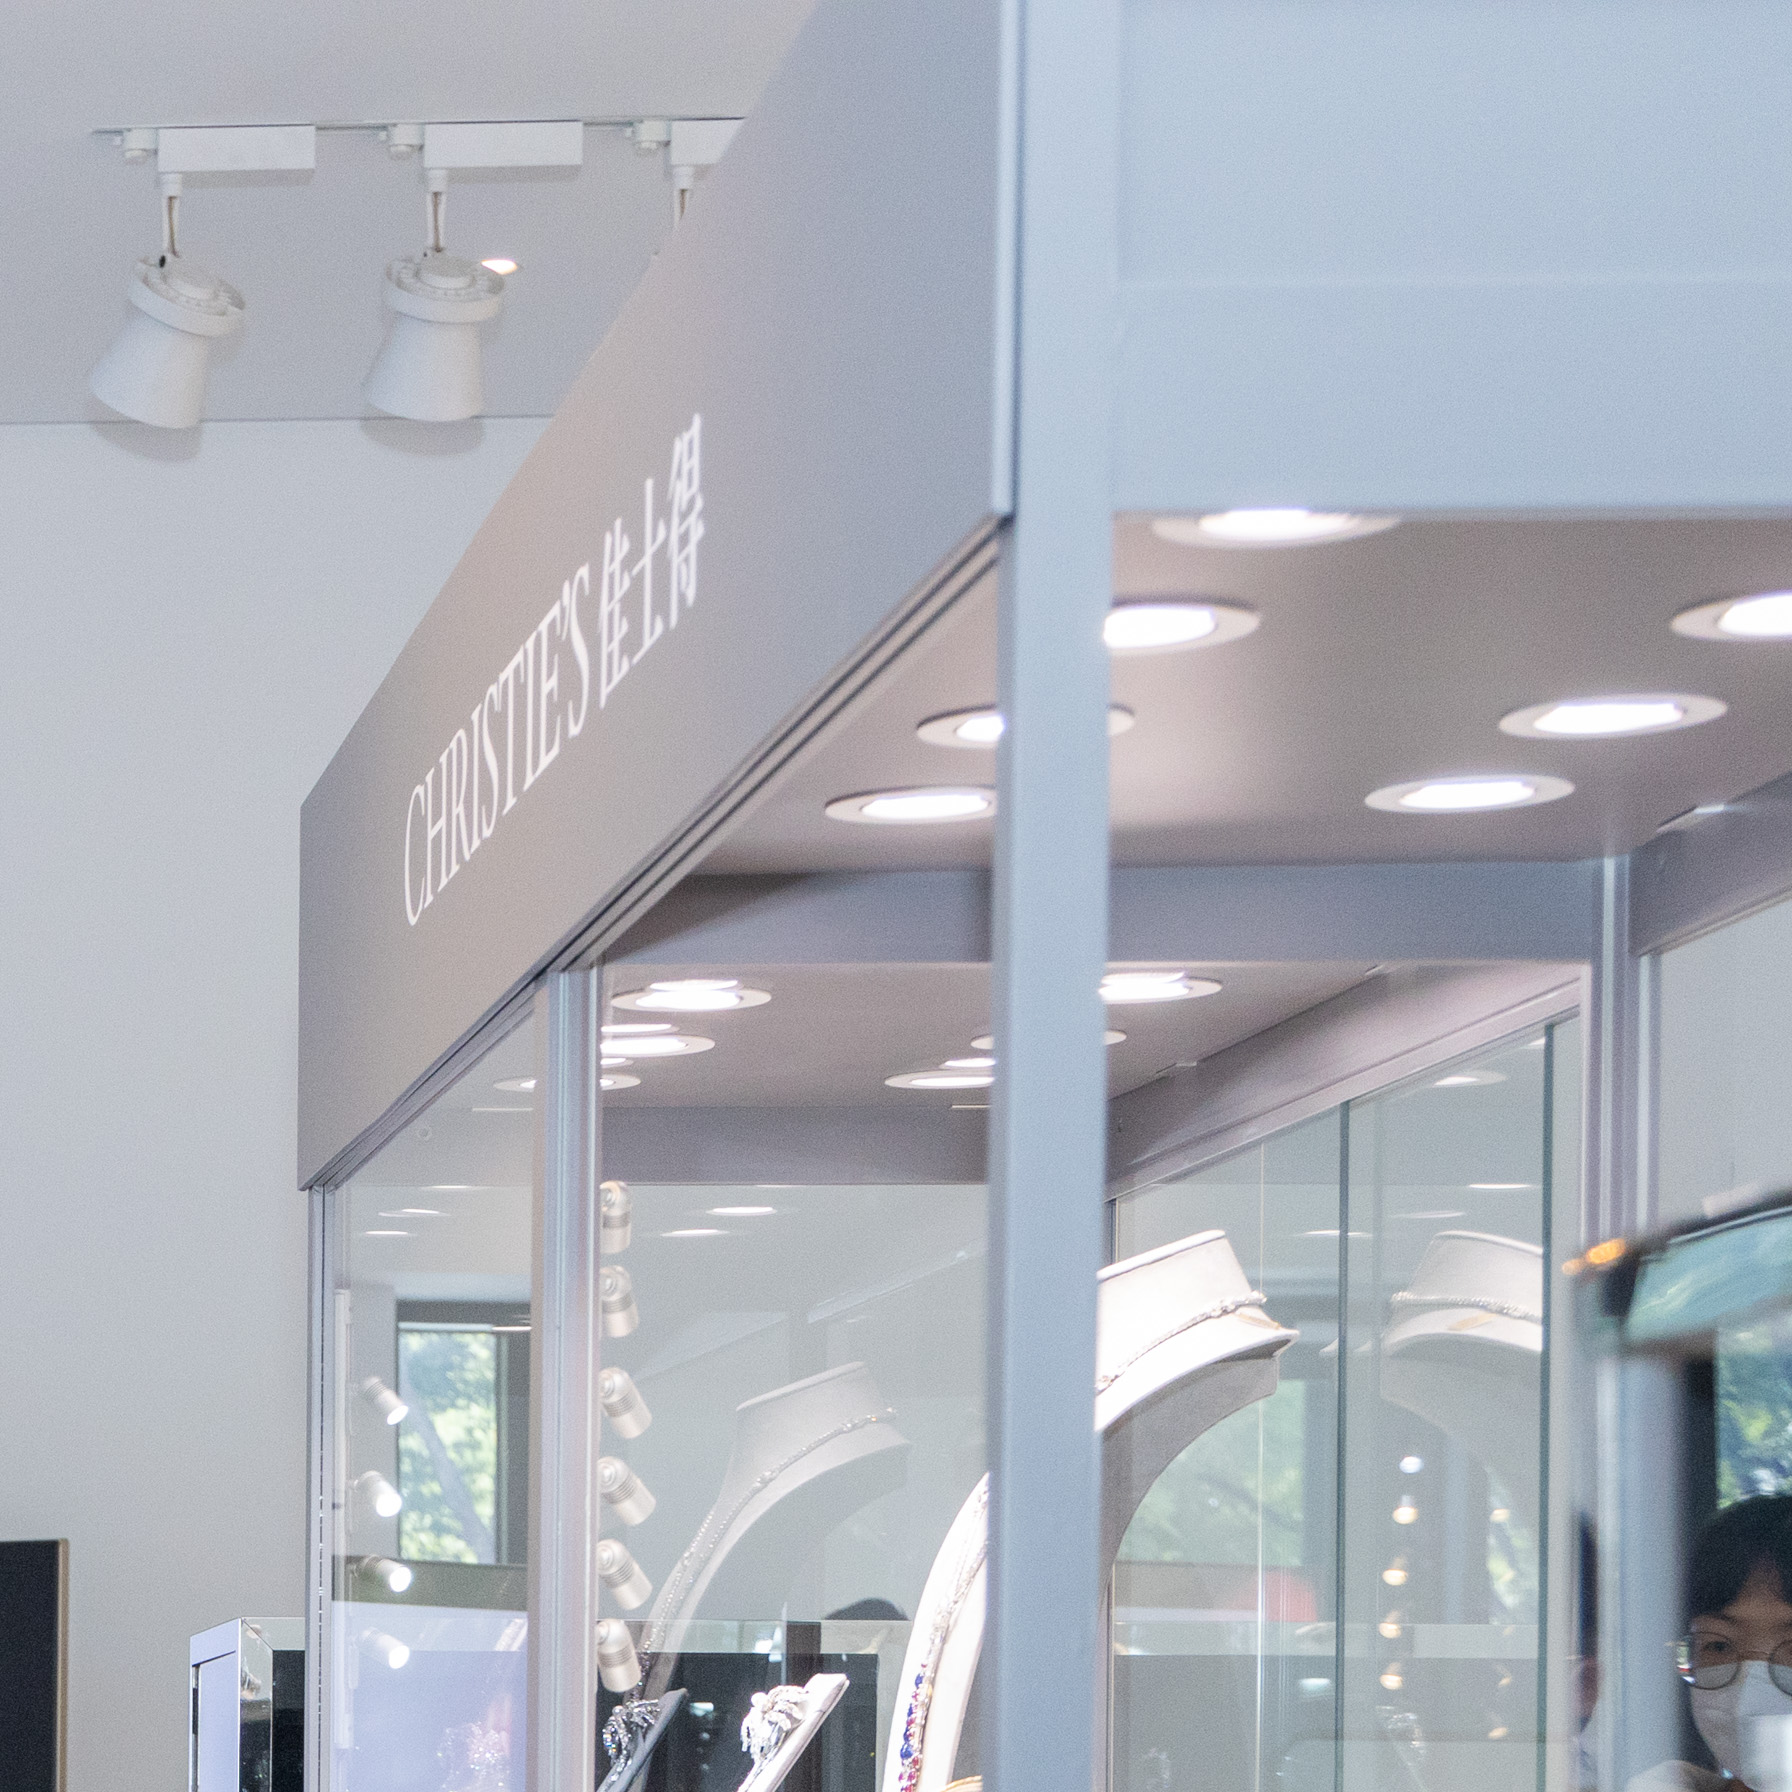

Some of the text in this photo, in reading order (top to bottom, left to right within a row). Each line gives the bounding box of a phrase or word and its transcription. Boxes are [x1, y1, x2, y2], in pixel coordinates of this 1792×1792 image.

[404, 413, 705, 926] CHRISTIE'S 佳士得
